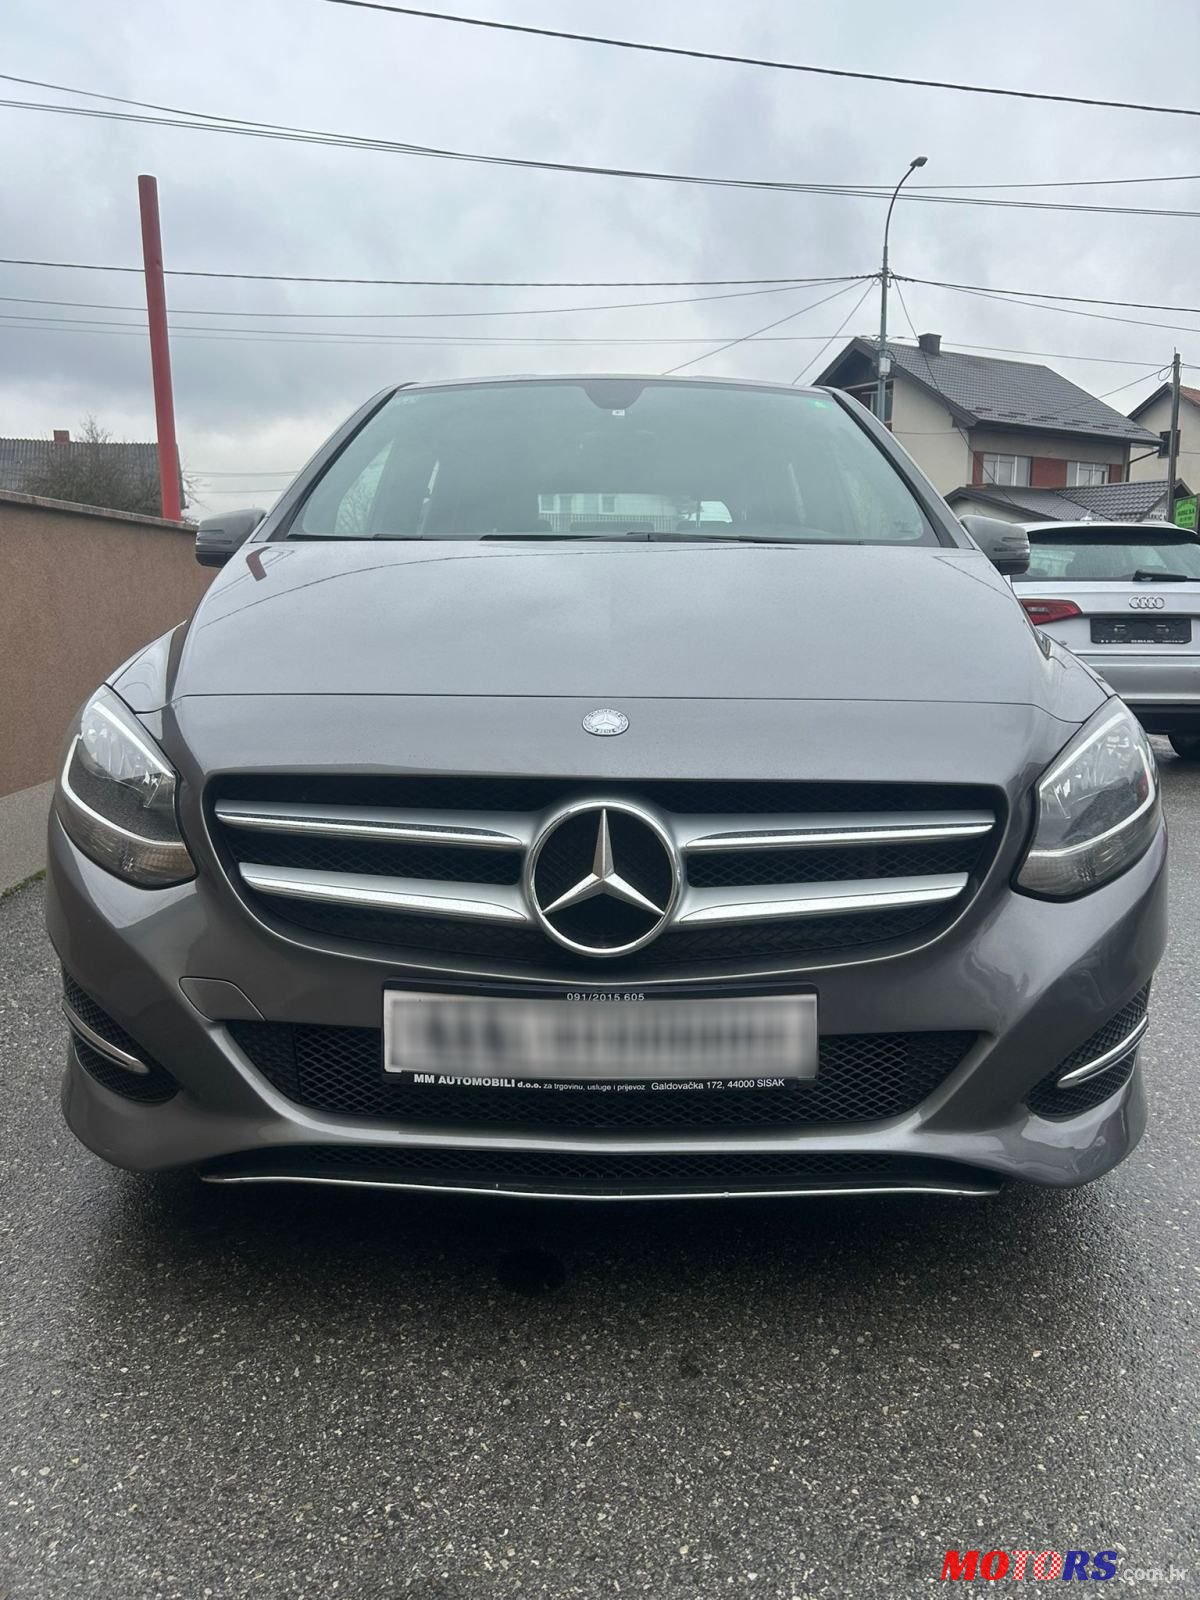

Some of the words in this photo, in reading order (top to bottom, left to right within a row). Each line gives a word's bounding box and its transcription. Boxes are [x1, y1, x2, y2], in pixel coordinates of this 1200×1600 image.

[567, 992, 620, 1001] 091/2015
[623, 993, 645, 1001] 605
[413, 1073, 435, 1084] MM
[438, 1075, 516, 1088] AUTOMOBILI
[517, 1081, 542, 1089] d.o.o.
[587, 1084, 612, 1093] usluge
[617, 1084, 646, 1093] prijevoz
[651, 1081, 704, 1091] Galdovačka
[706, 1081, 725, 1090] 172,
[727, 1080, 755, 1089] 44000
[756, 1078, 785, 1088] SISAK
